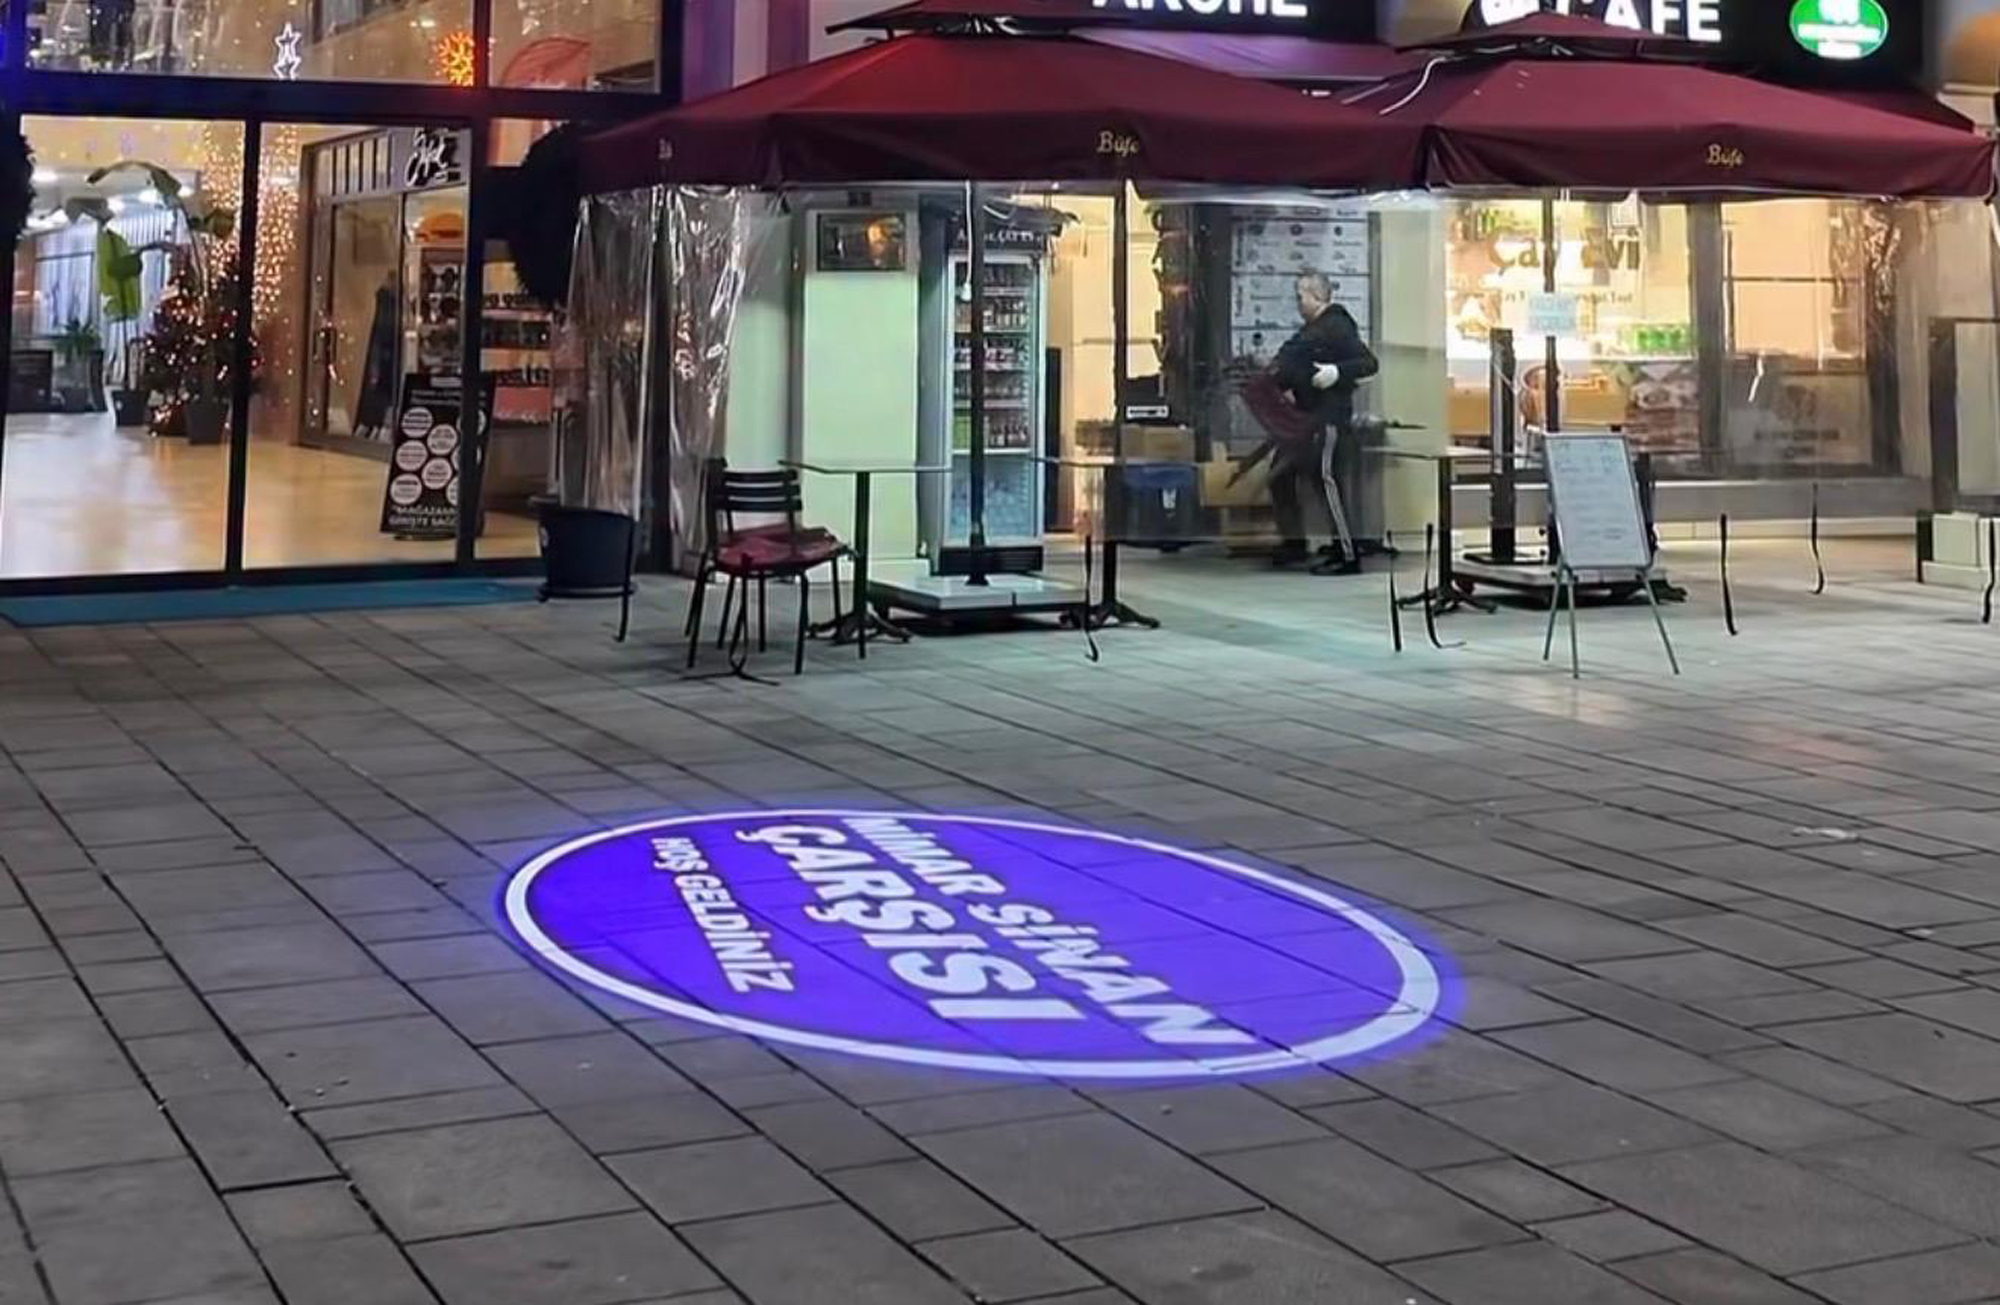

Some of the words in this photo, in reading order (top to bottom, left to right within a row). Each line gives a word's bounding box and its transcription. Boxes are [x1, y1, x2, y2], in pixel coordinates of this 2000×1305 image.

[651, 838, 708, 871] HOŞ
[735, 825, 1087, 1018] ÇARŞISI
[840, 818, 1006, 894] MİMAR
[967, 903, 1258, 1043] SİNAN
[674, 874, 794, 992] GELDİNİZ
